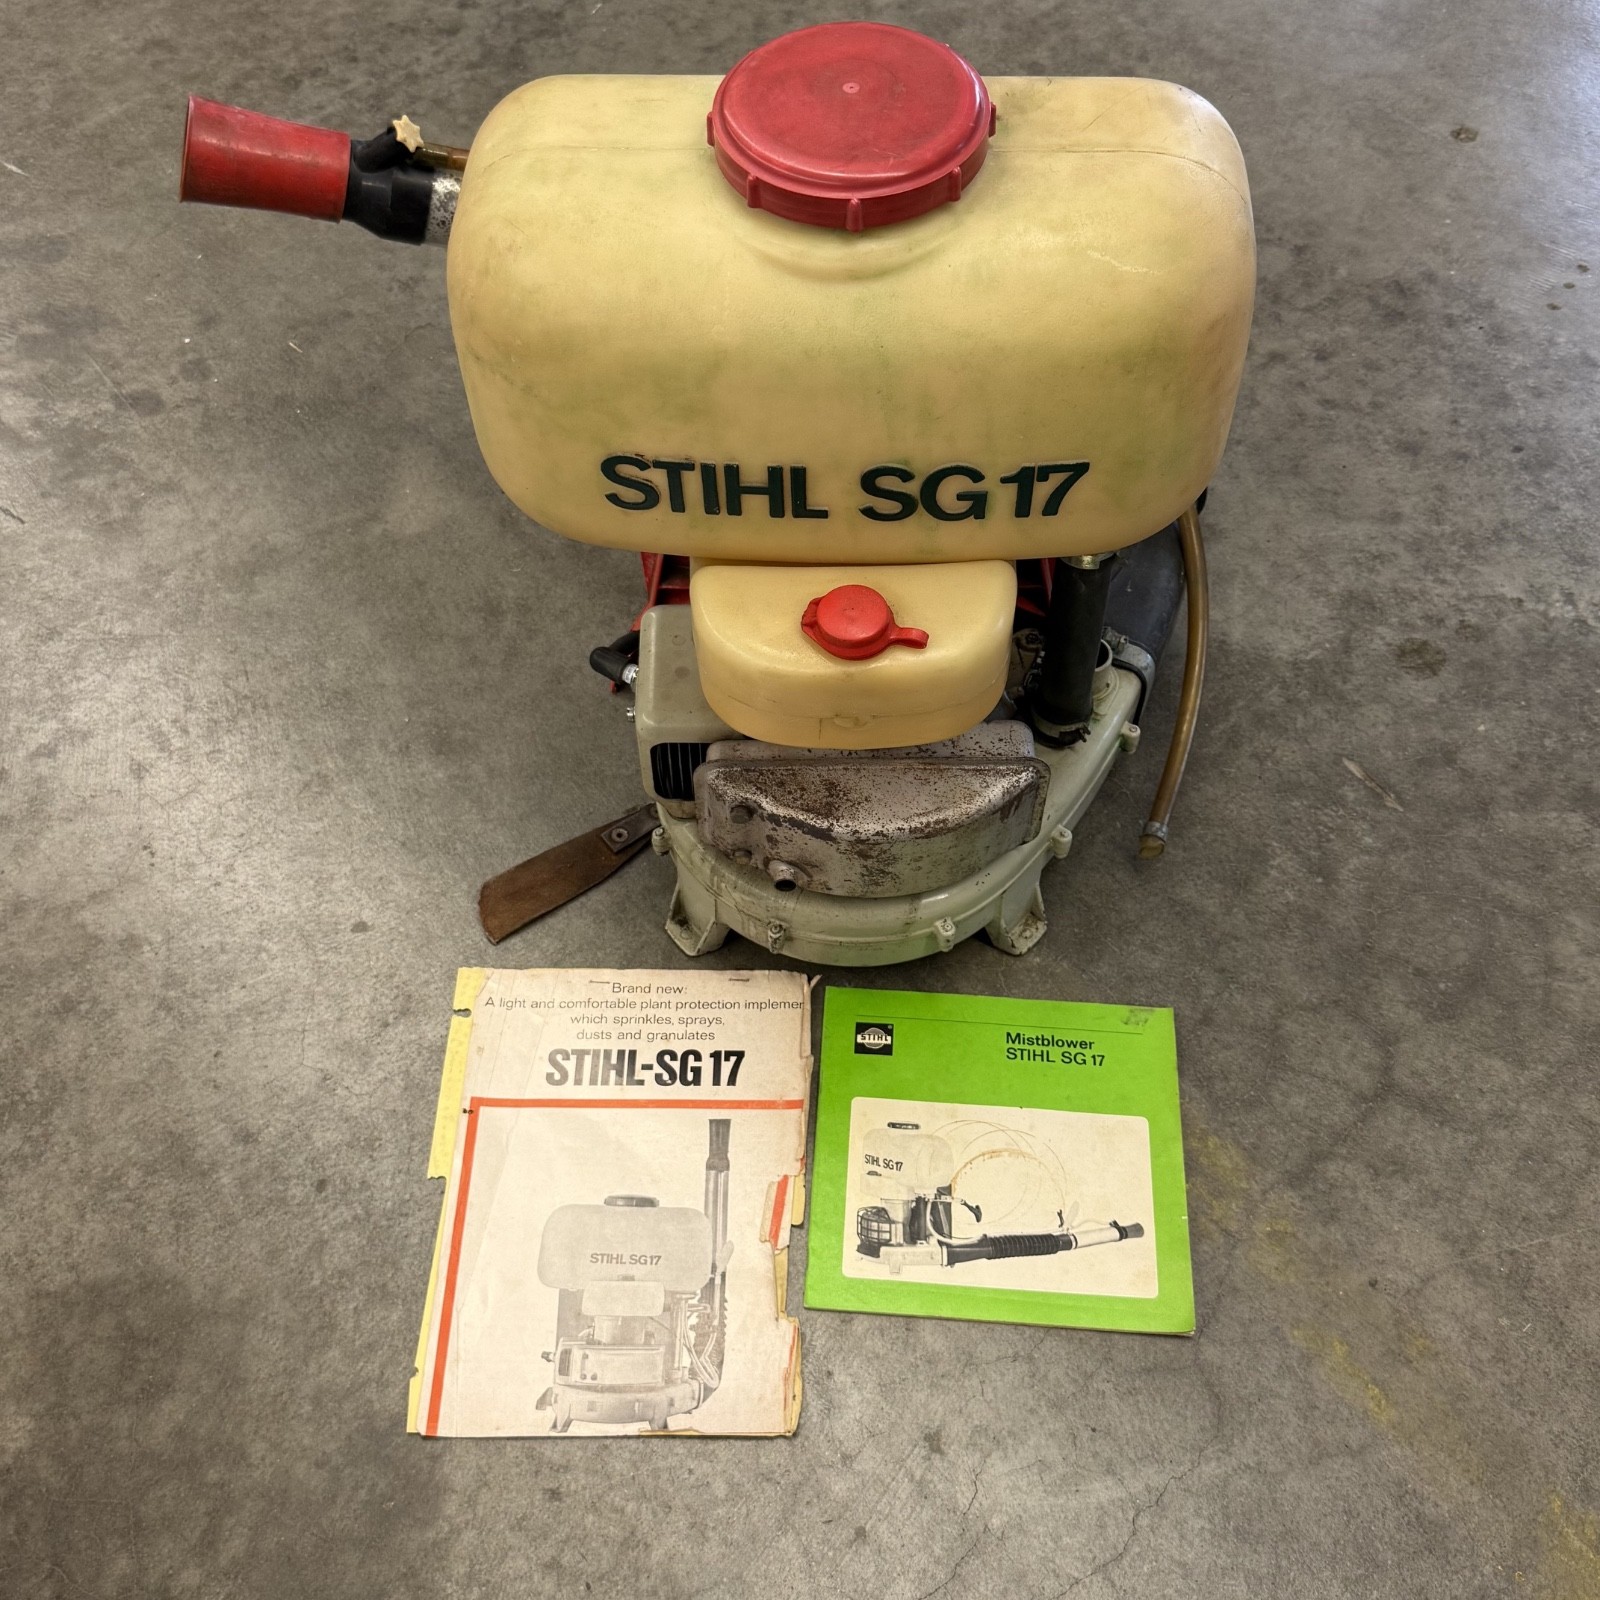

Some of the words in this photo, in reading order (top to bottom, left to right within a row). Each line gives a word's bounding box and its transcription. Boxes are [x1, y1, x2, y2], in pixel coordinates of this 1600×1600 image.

[600, 454, 829, 519] STIHL
[859, 464, 988, 522] SG
[999, 461, 1091, 518] 17
[612, 982, 652, 995] Brand
[657, 985, 688, 994] new:
[485, 997, 495, 1008] A
[500, 998, 526, 1011] light
[531, 998, 555, 1009] and
[559, 998, 637, 1010] comfortable
[641, 998, 672, 1012] plant
[676, 999, 741, 1013] protection
[570, 1014, 609, 1025] which
[613, 1014, 675, 1028] sprinkles,
[678, 1016, 725, 1028] sprays,
[576, 1029, 612, 1041] dusts
[617, 1030, 642, 1041] and
[647, 1029, 715, 1043] granulates
[860, 1033, 889, 1042] STIHL
[1006, 1031, 1095, 1050] Mistblower
[1006, 1047, 1056, 1063] STIHL
[1061, 1051, 1087, 1065] SG
[1091, 1054, 1105, 1067] 17
[545, 1048, 703, 1087] STIHL-SG
[709, 1049, 746, 1087] 17
[864, 1154, 881, 1168] STIHL
[882, 1158, 895, 1170] SG
[895, 1161, 904, 1172] 17
[589, 1253, 627, 1265] STIHL
[628, 1254, 647, 1265] SG
[648, 1255, 662, 1266] 17
